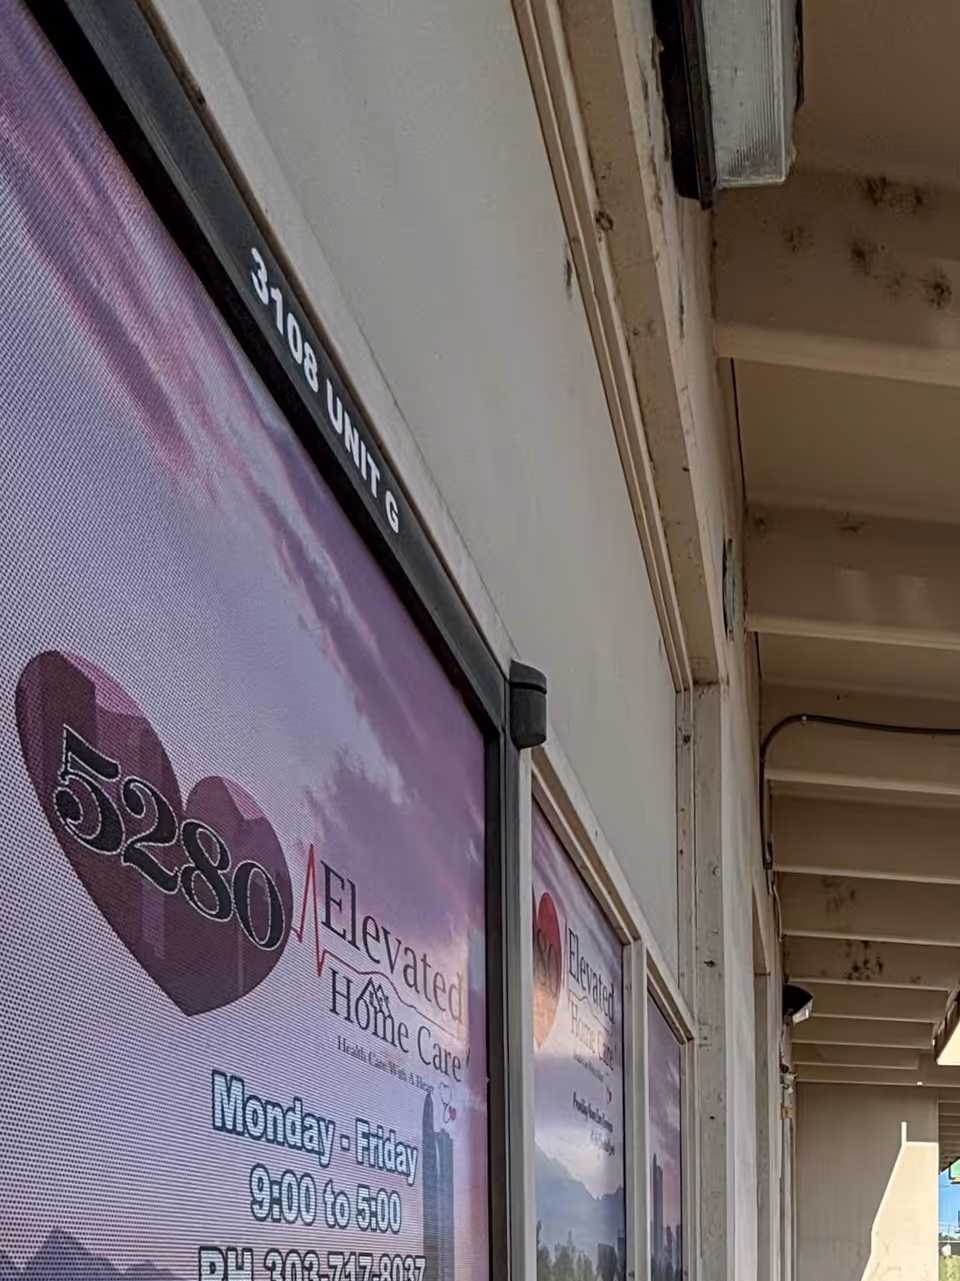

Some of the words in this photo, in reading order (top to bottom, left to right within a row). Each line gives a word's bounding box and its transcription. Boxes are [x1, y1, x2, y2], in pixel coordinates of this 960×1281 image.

[250, 247, 320, 394] 3108
[326, 378, 381, 499] UNIT
[385, 490, 399, 534] G
[53, 723, 286, 951] 5280
[320, 859, 464, 1025] Elevated
[568, 928, 615, 1025] Elevated
[328, 966, 409, 1054] Home
[417, 1025, 462, 1083] Care
[337, 1034, 366, 1062] Health
[367, 1050, 387, 1071] Care
[570, 999, 595, 1054] Home
[212, 1069, 336, 1168] Monday
[355, 1117, 418, 1187] Friday
[250, 1163, 318, 1227] 9:00
[323, 1179, 350, 1230] to
[356, 1183, 402, 1235] 5:00
